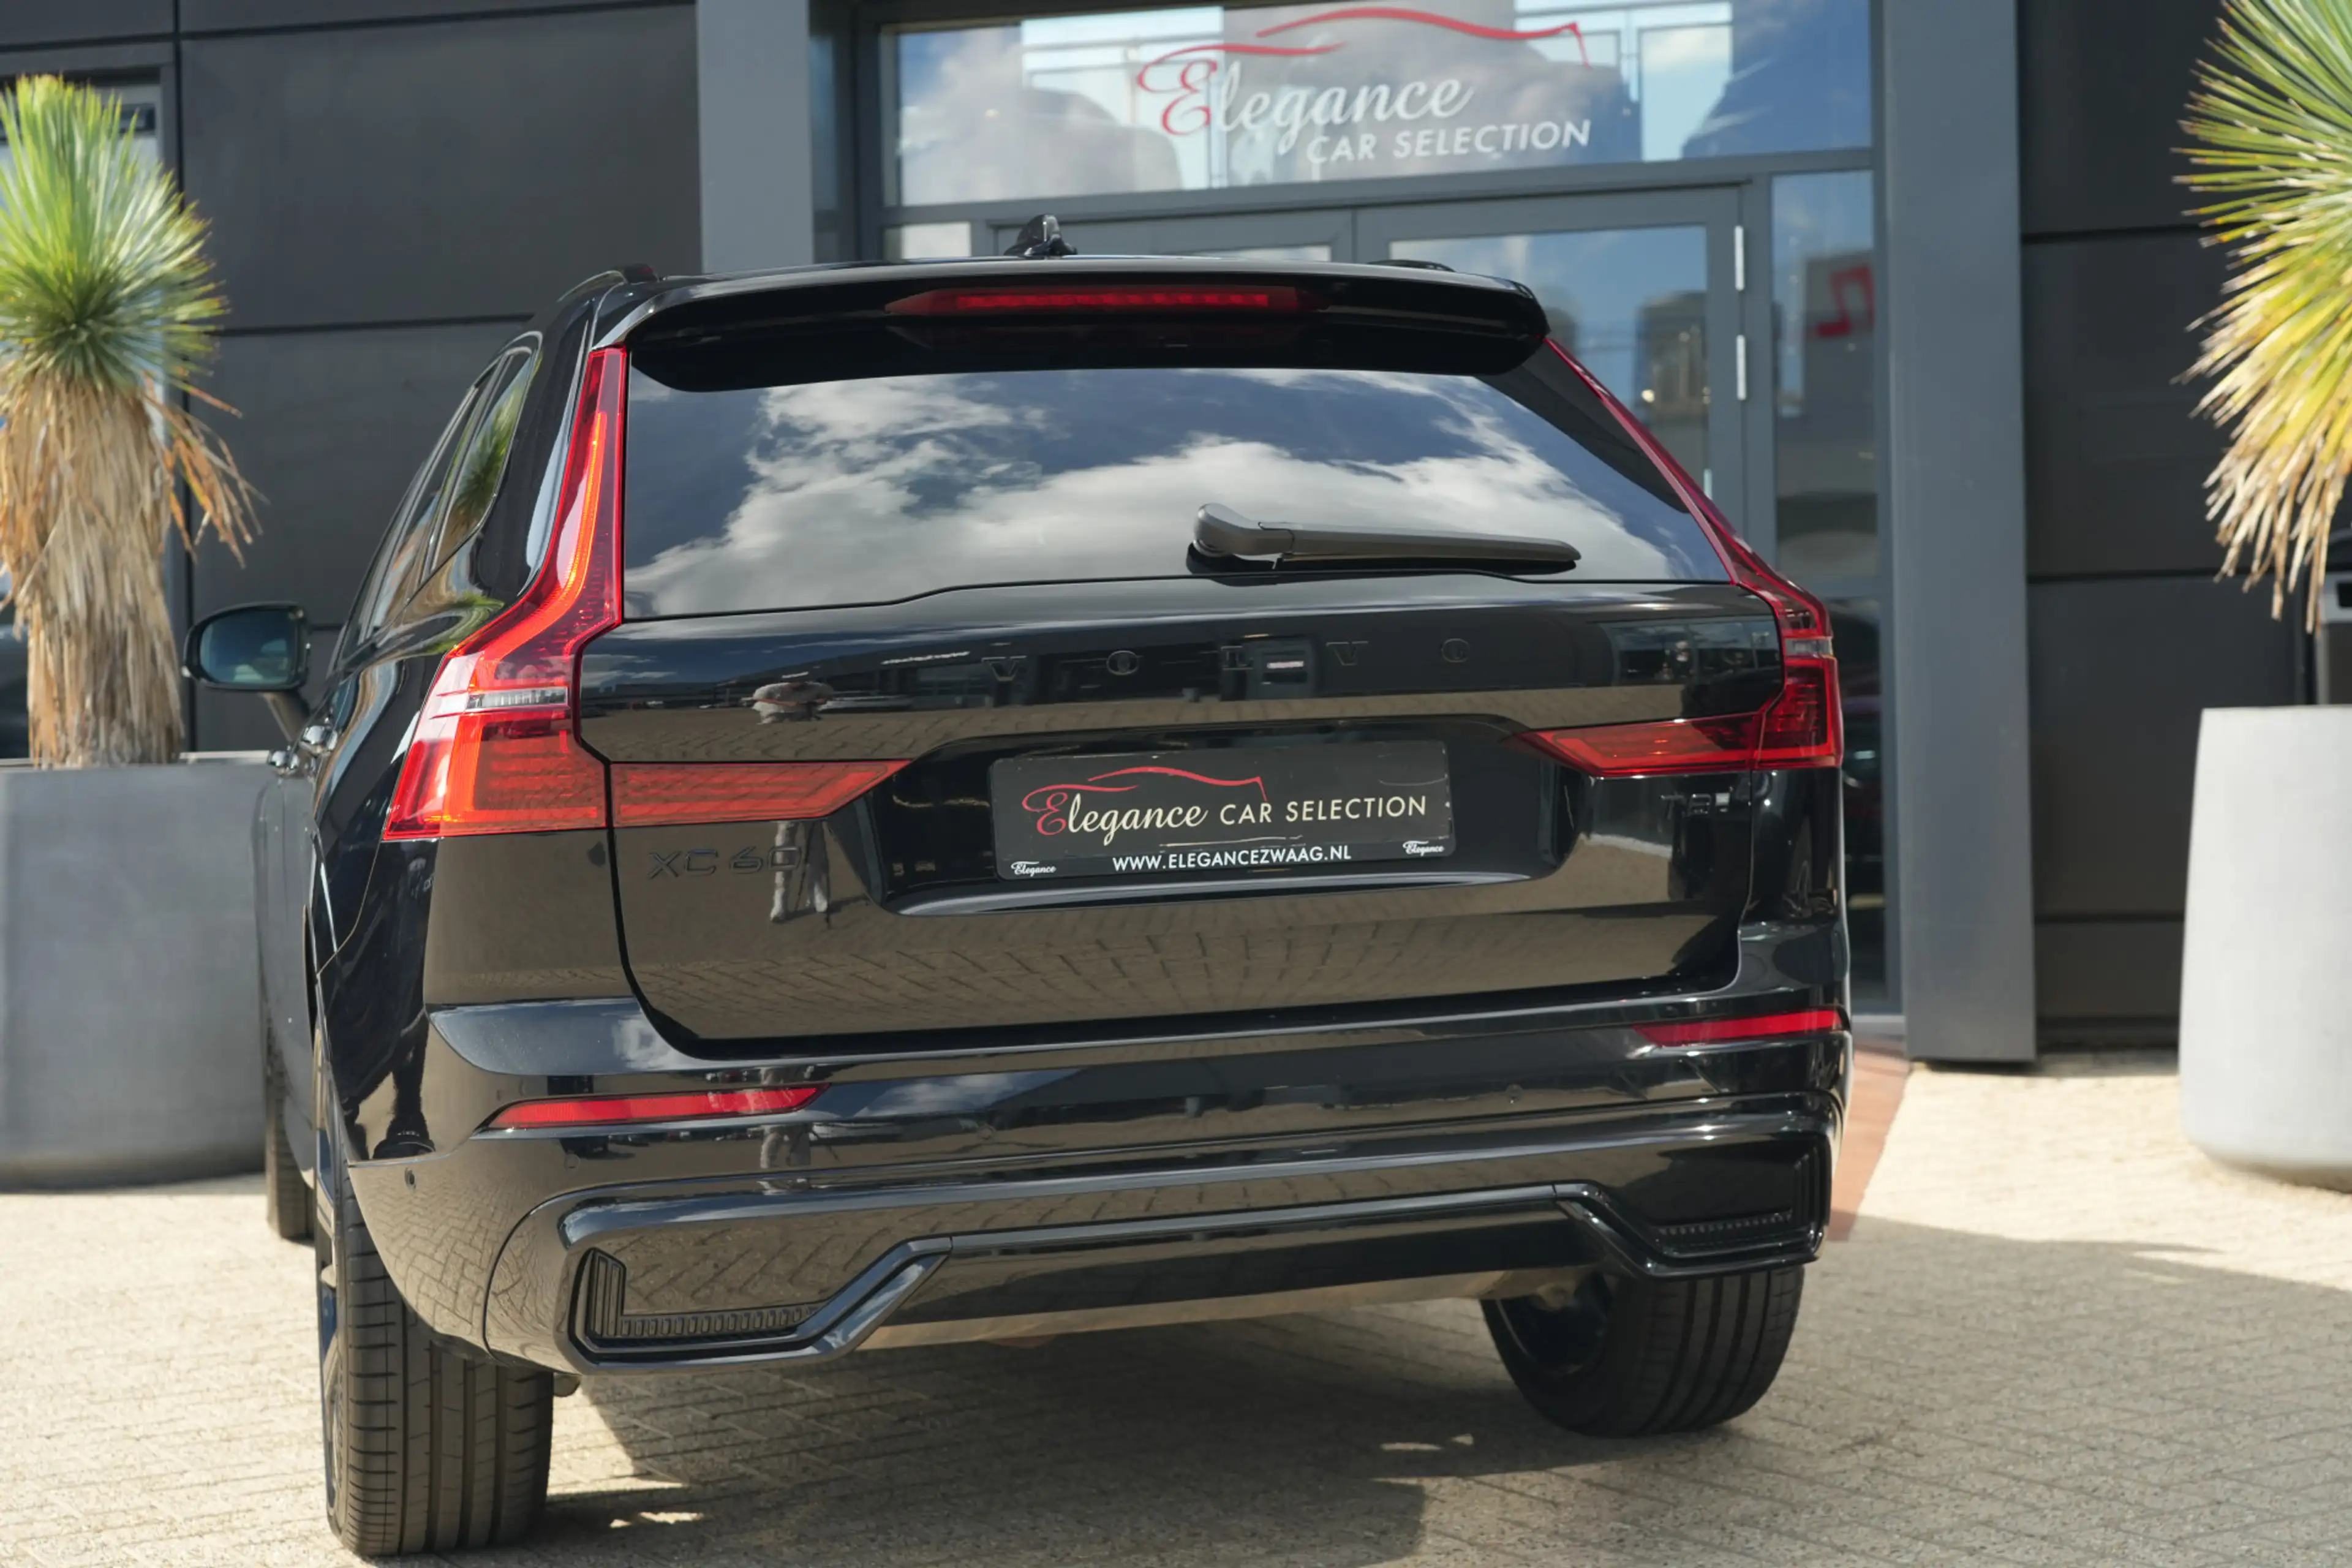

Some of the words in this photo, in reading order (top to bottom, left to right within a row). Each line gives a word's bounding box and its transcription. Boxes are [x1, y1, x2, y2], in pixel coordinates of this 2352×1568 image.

[1137, 43, 1474, 156] Elegance
[1306, 134, 1376, 164] CAR
[1393, 119, 1592, 159] SELECTION
[981, 637, 1470, 682] VOLVO
[1022, 784, 1208, 846] Elegance
[1219, 802, 1273, 826] CAR
[1285, 795, 1427, 823] SELECTION
[1011, 860, 1057, 878] Elegance
[1112, 845, 1352, 872] WWW.ELEGANCEZWAAG.NL
[1403, 840, 1445, 857] Elegance
